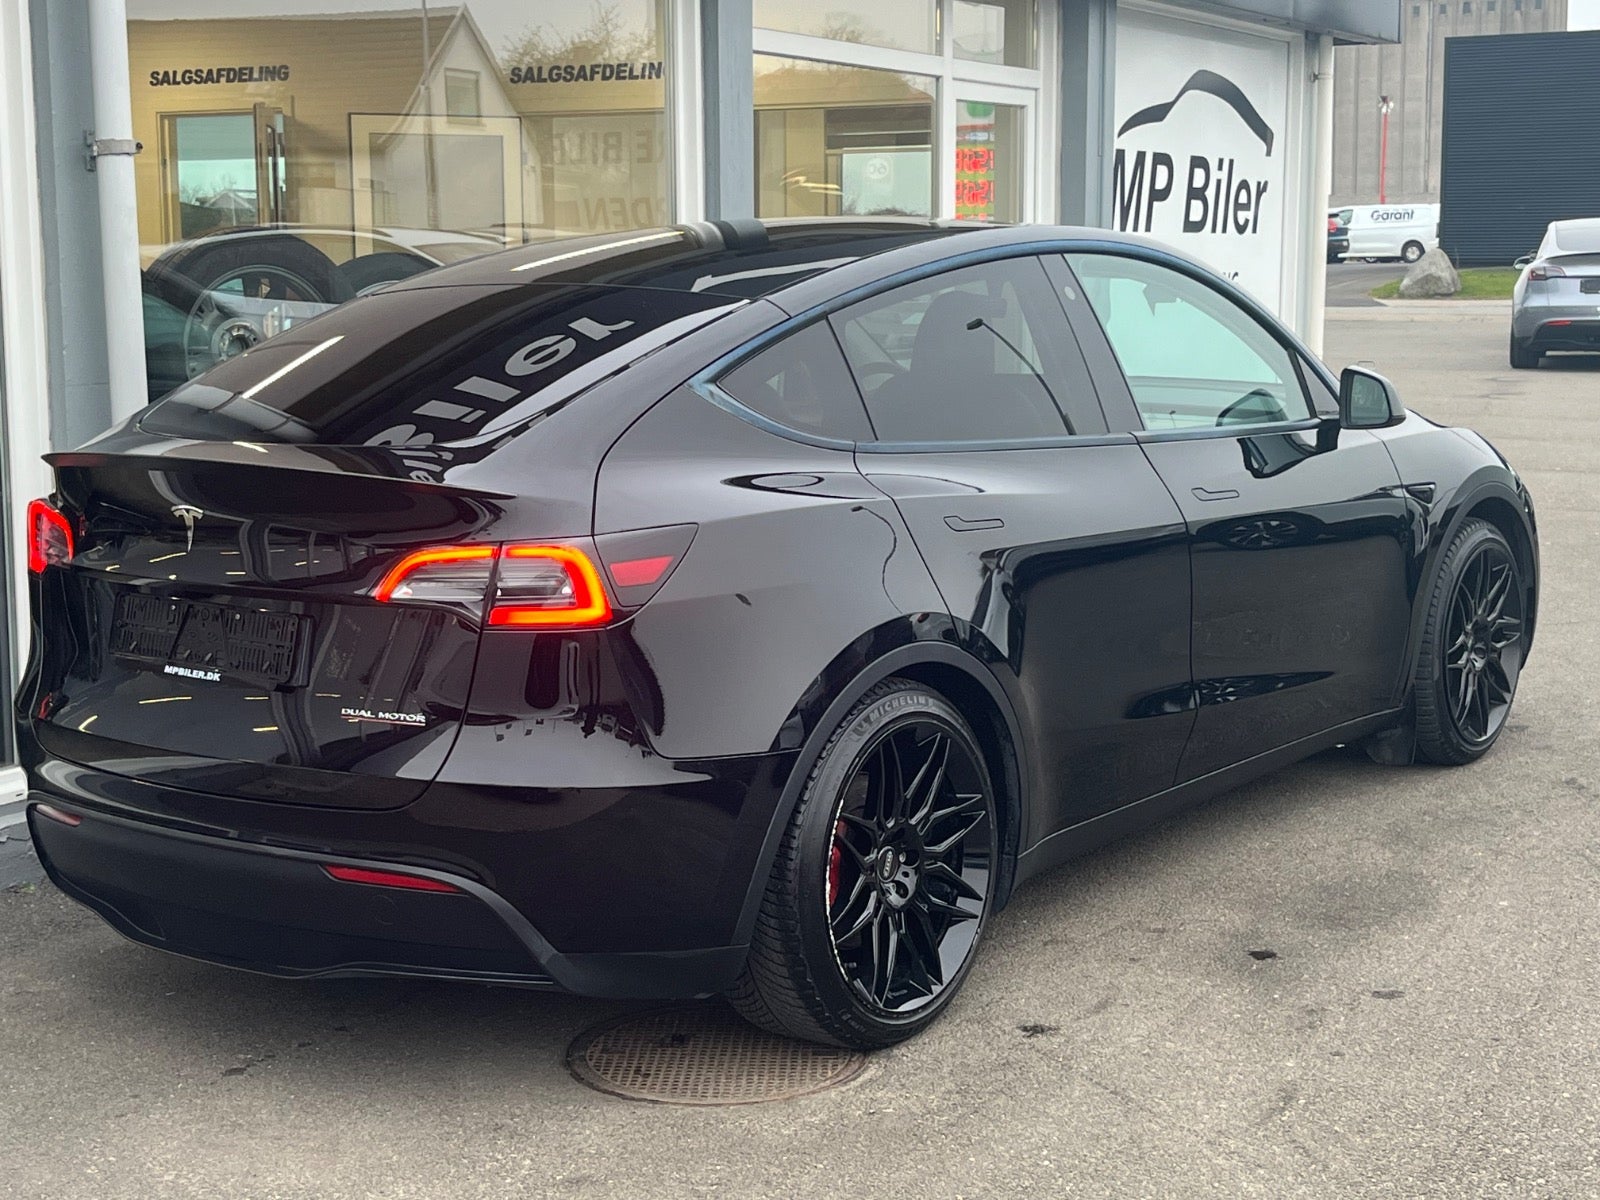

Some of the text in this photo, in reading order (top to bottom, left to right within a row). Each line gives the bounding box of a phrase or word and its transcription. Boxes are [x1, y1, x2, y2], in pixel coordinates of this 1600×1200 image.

[149, 65, 290, 87] SALGSAFDELING
[510, 62, 665, 84] SALGSAFDELIN
[1112, 148, 1268, 235] MP Biler
[1371, 209, 1414, 221] Garant
[164, 665, 221, 682] MPBILER.DK
[341, 708, 426, 723] DUAL MOTOR
[869, 695, 926, 722] MICHELIN
